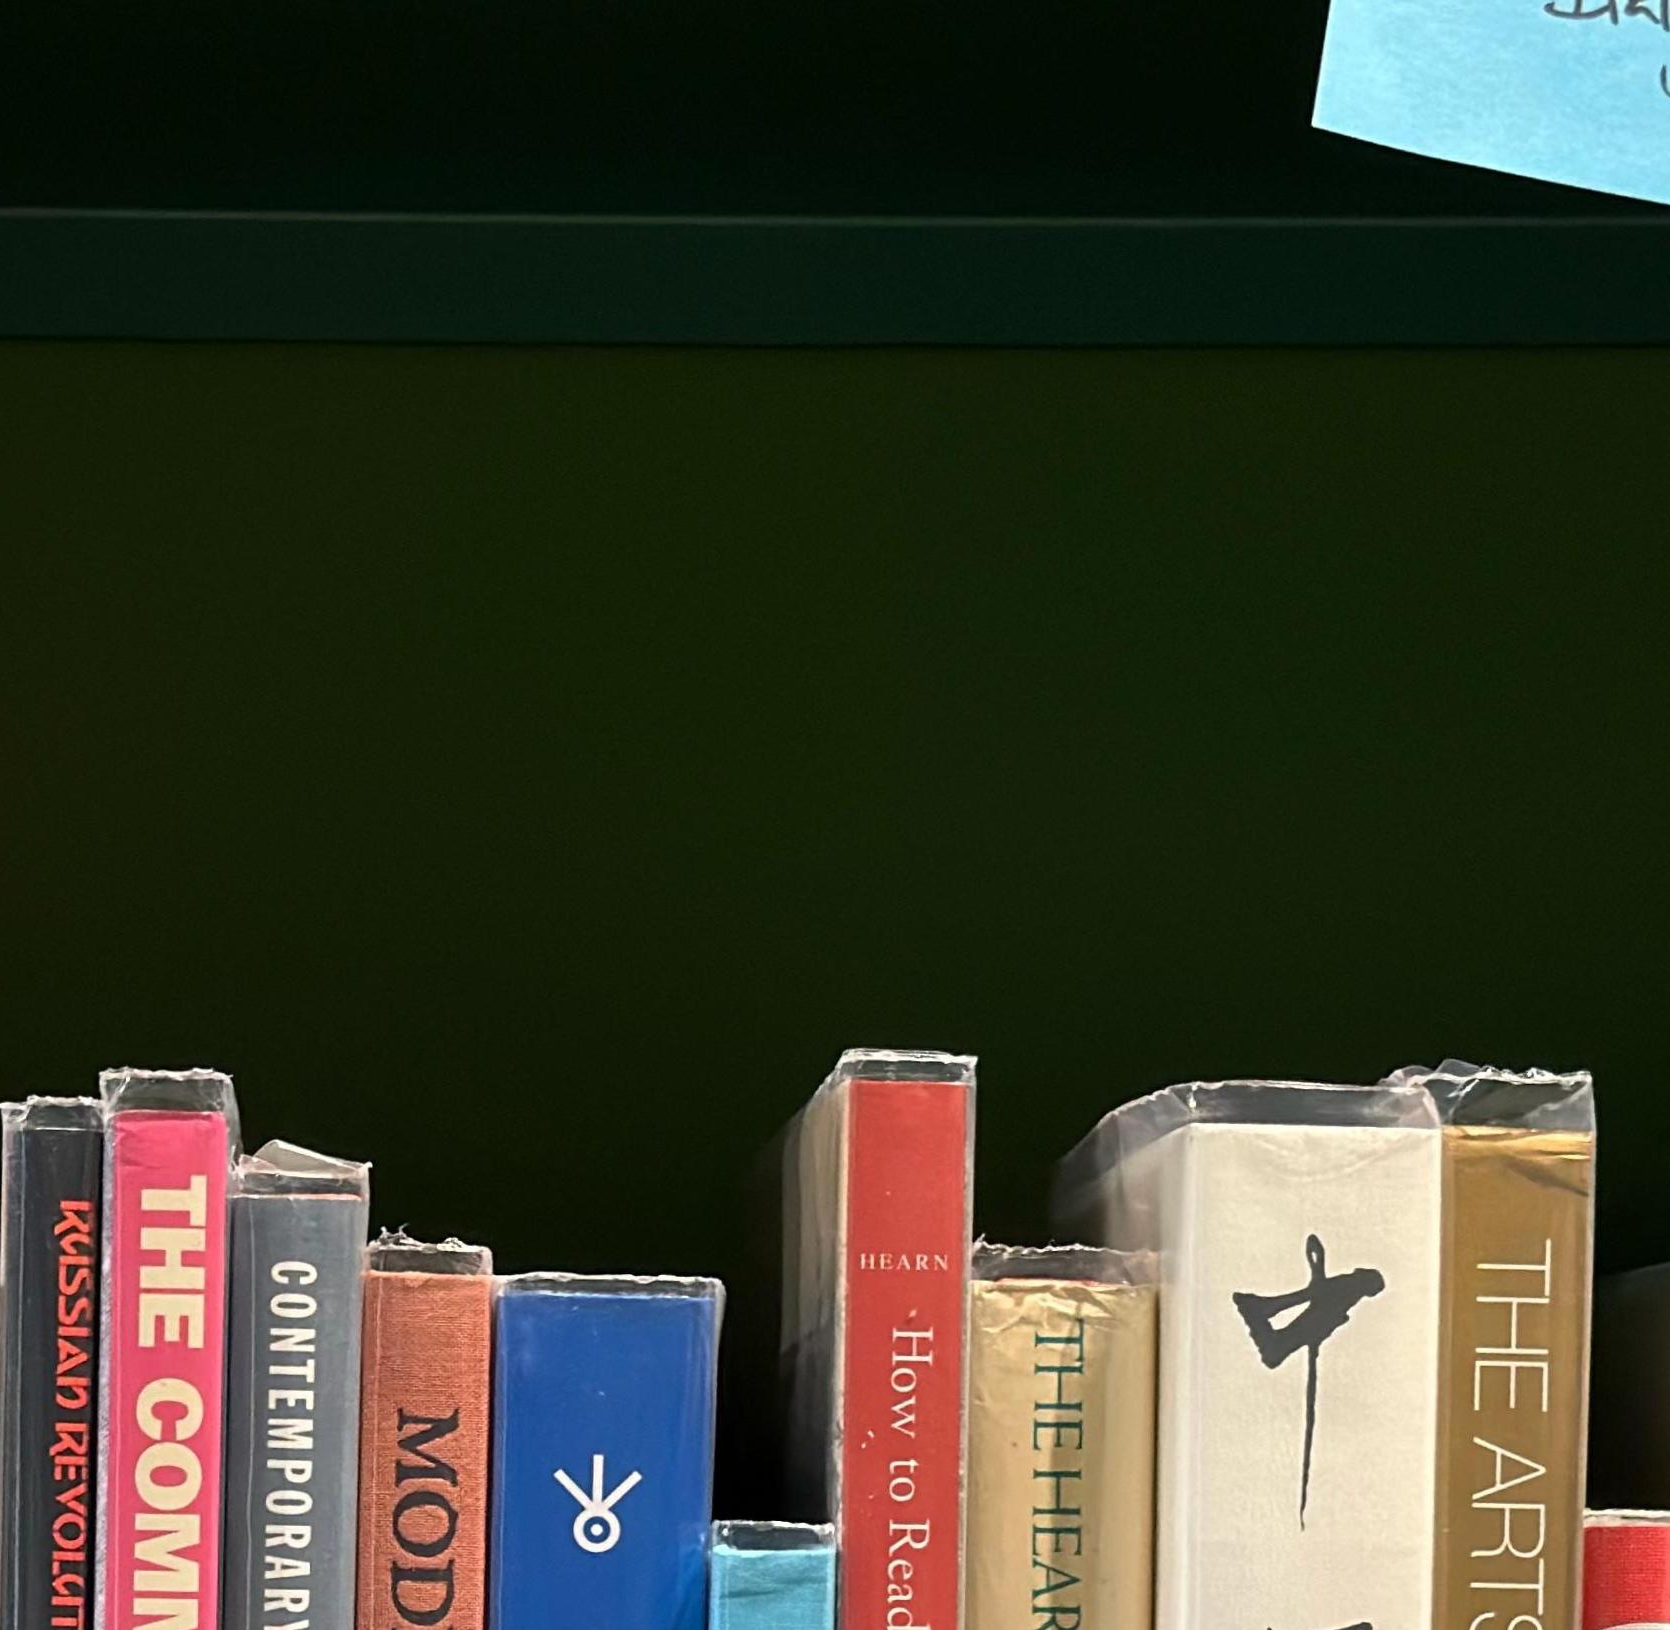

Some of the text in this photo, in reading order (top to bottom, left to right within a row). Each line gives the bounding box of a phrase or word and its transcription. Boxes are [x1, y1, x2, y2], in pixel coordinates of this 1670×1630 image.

[137, 1173, 209, 1349] THE
[889, 1325, 935, 1438] How
[1033, 1323, 1084, 1450] THE
[1474, 1239, 1552, 1411] THE
[887, 1460, 914, 1503] to
